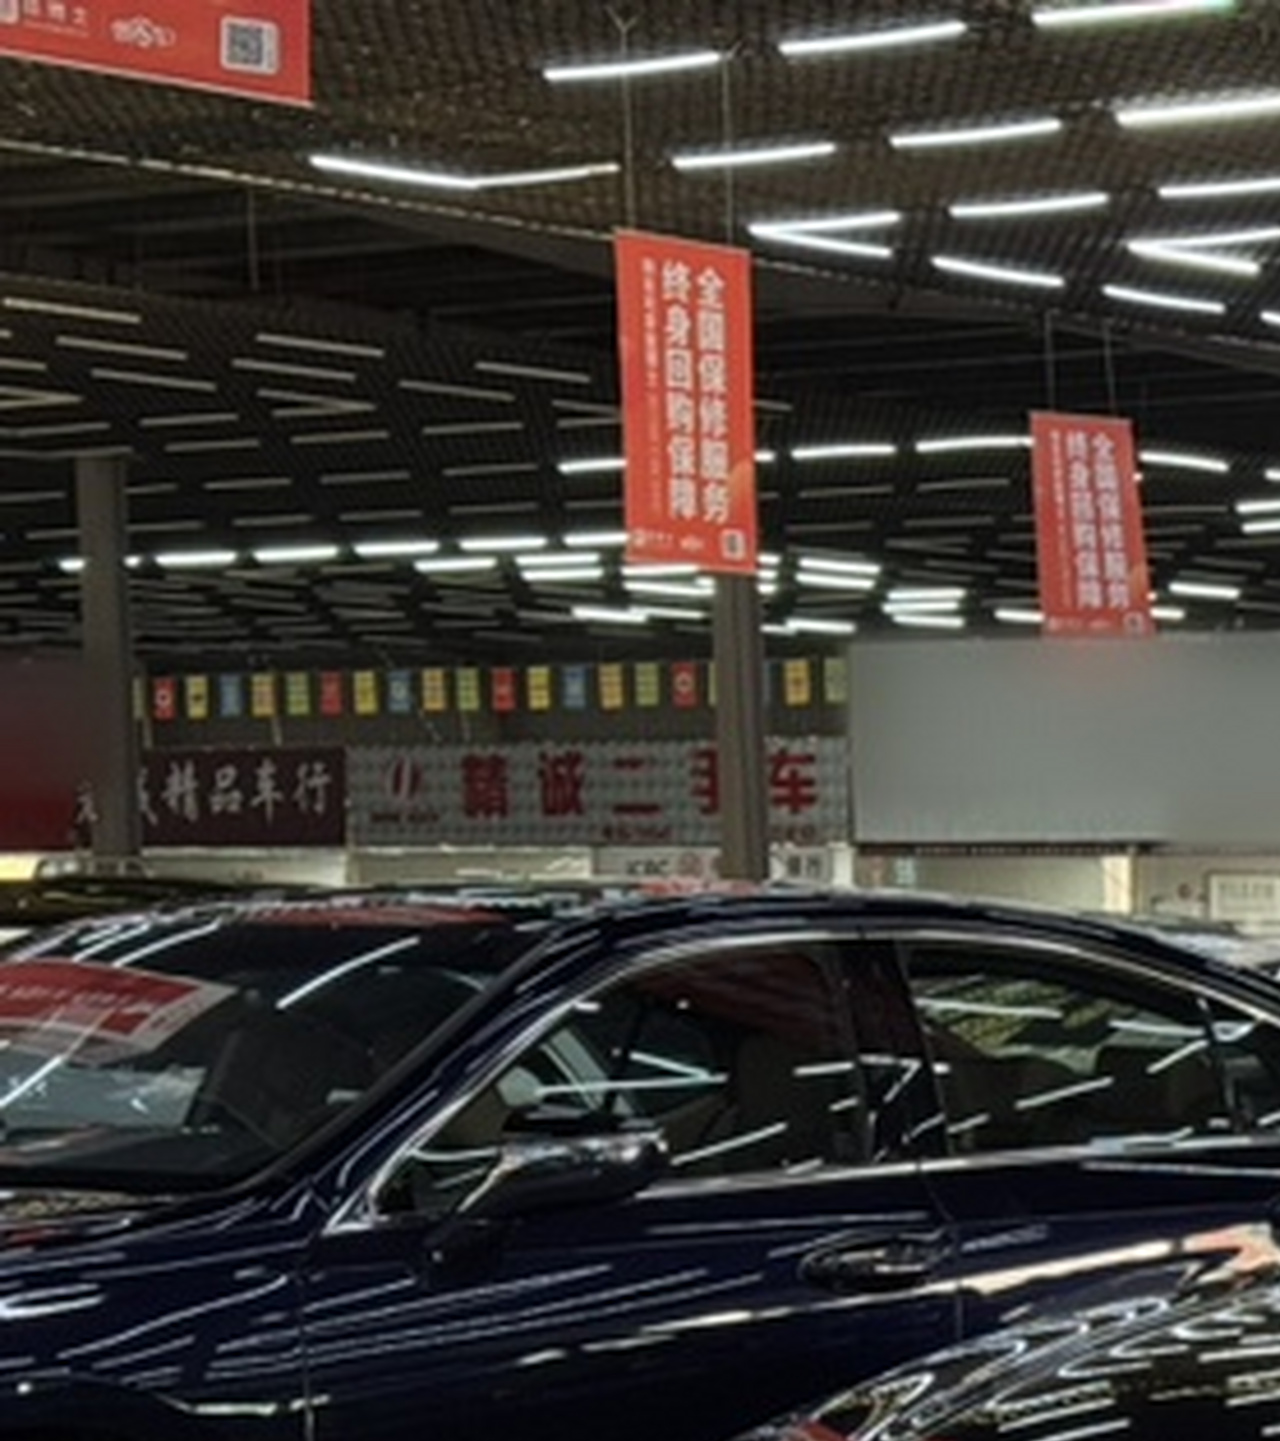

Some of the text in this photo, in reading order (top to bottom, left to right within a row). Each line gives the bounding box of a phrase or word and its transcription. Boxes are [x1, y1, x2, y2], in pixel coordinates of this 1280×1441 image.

[696, 266, 730, 525] 全国保修服务
